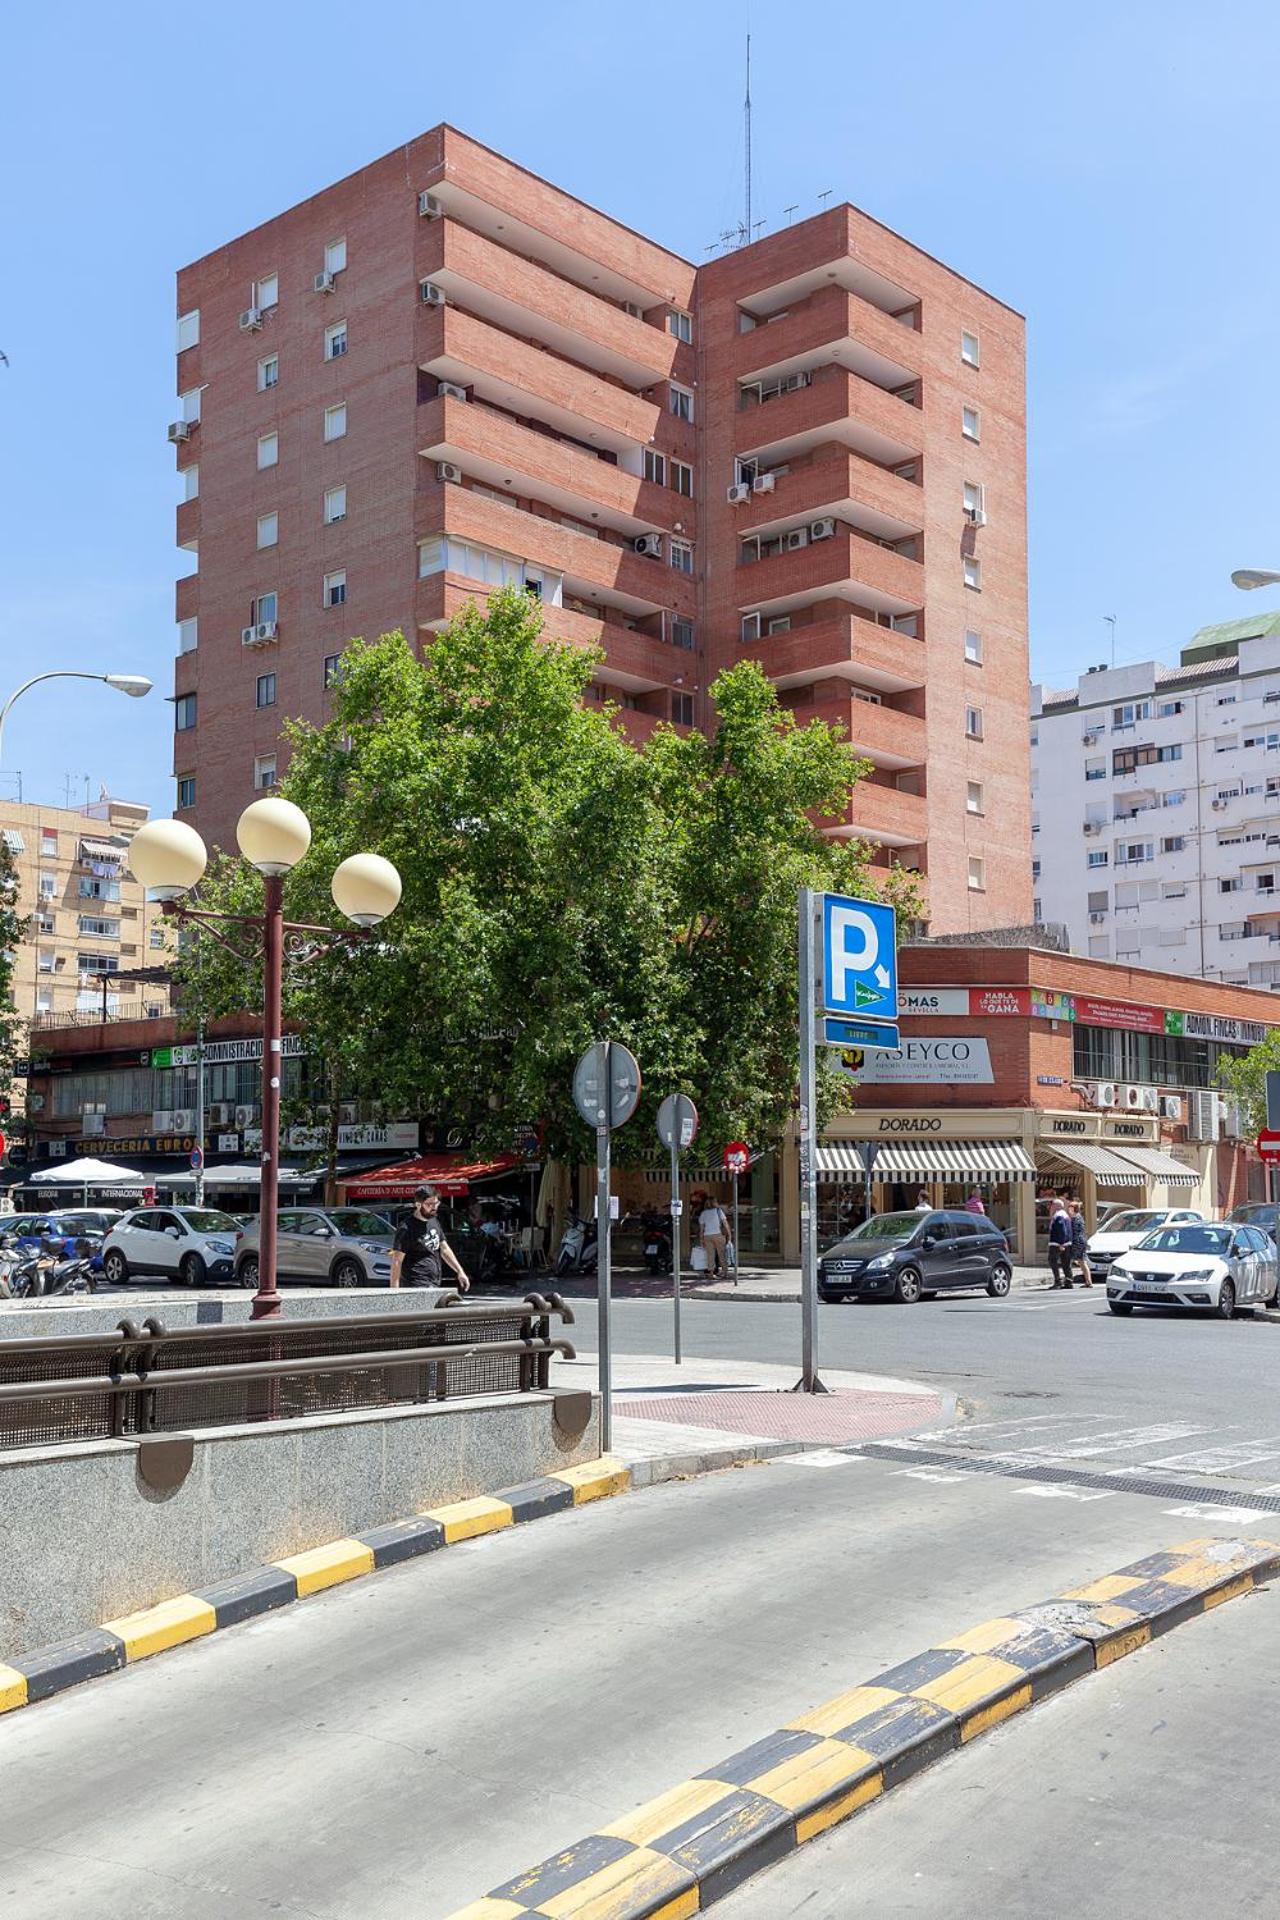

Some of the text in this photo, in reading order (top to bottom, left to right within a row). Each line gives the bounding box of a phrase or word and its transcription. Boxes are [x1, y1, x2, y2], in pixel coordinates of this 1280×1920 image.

[831, 905, 879, 1002] P
[987, 1004, 1020, 1014] GANA
[1214, 1017, 1236, 1040] FINCAS
[878, 1117, 942, 1132] DORADO
[1053, 1120, 1144, 1136] DORADO DORADO
[156, 1136, 211, 1152] EUROA
[101, 1189, 144, 1198] INTERNACIONAL
